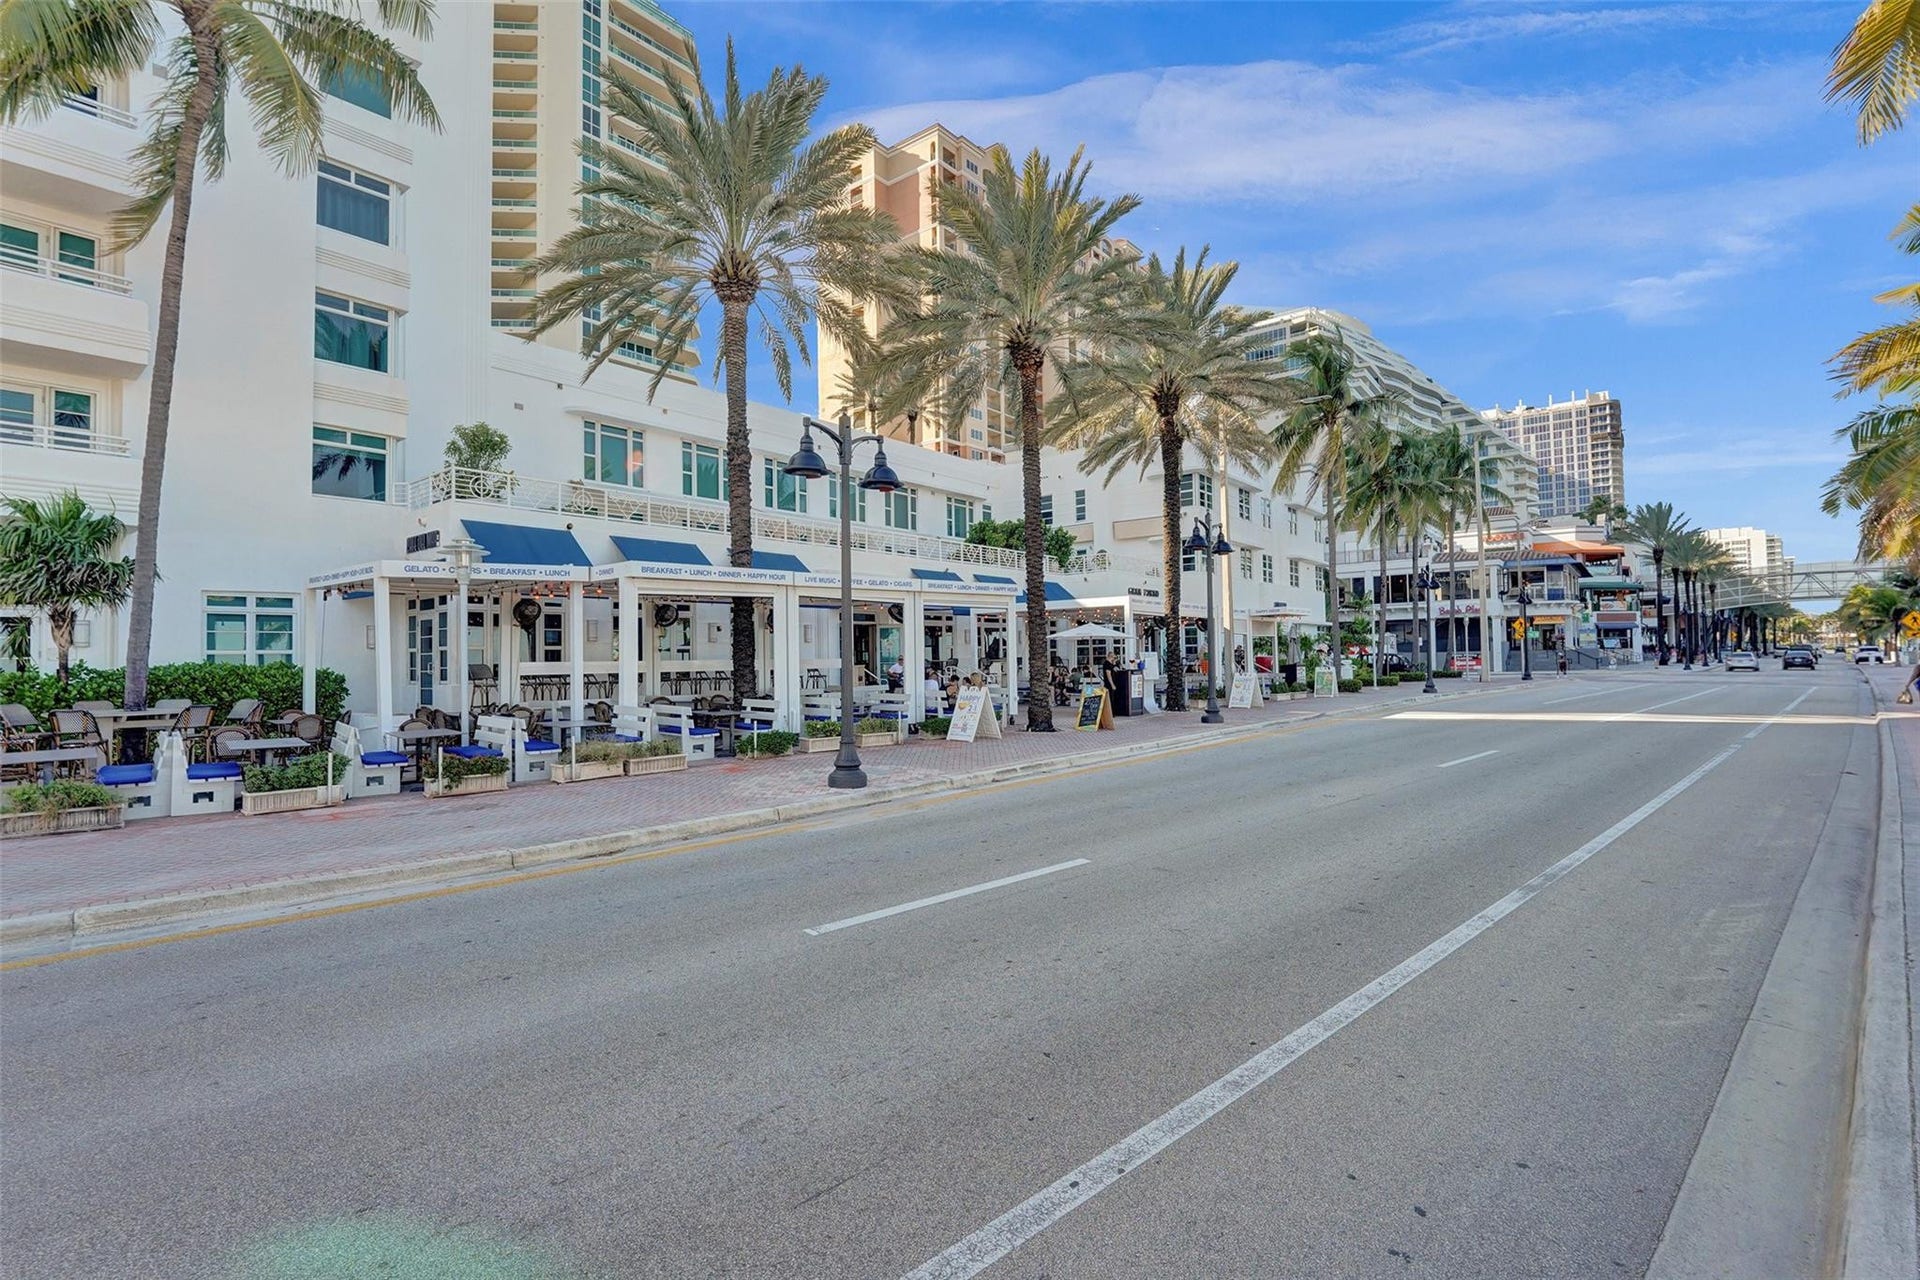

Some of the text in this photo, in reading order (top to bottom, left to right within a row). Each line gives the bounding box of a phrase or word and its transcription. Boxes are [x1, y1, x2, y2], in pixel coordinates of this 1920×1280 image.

[404, 564, 440, 574] GELATO
[448, 566, 482, 575] CRS
[490, 567, 537, 576] BREAKFAST
[641, 566, 786, 581] BREAKFAST LUNCH DINNER HAPPY HOUR
